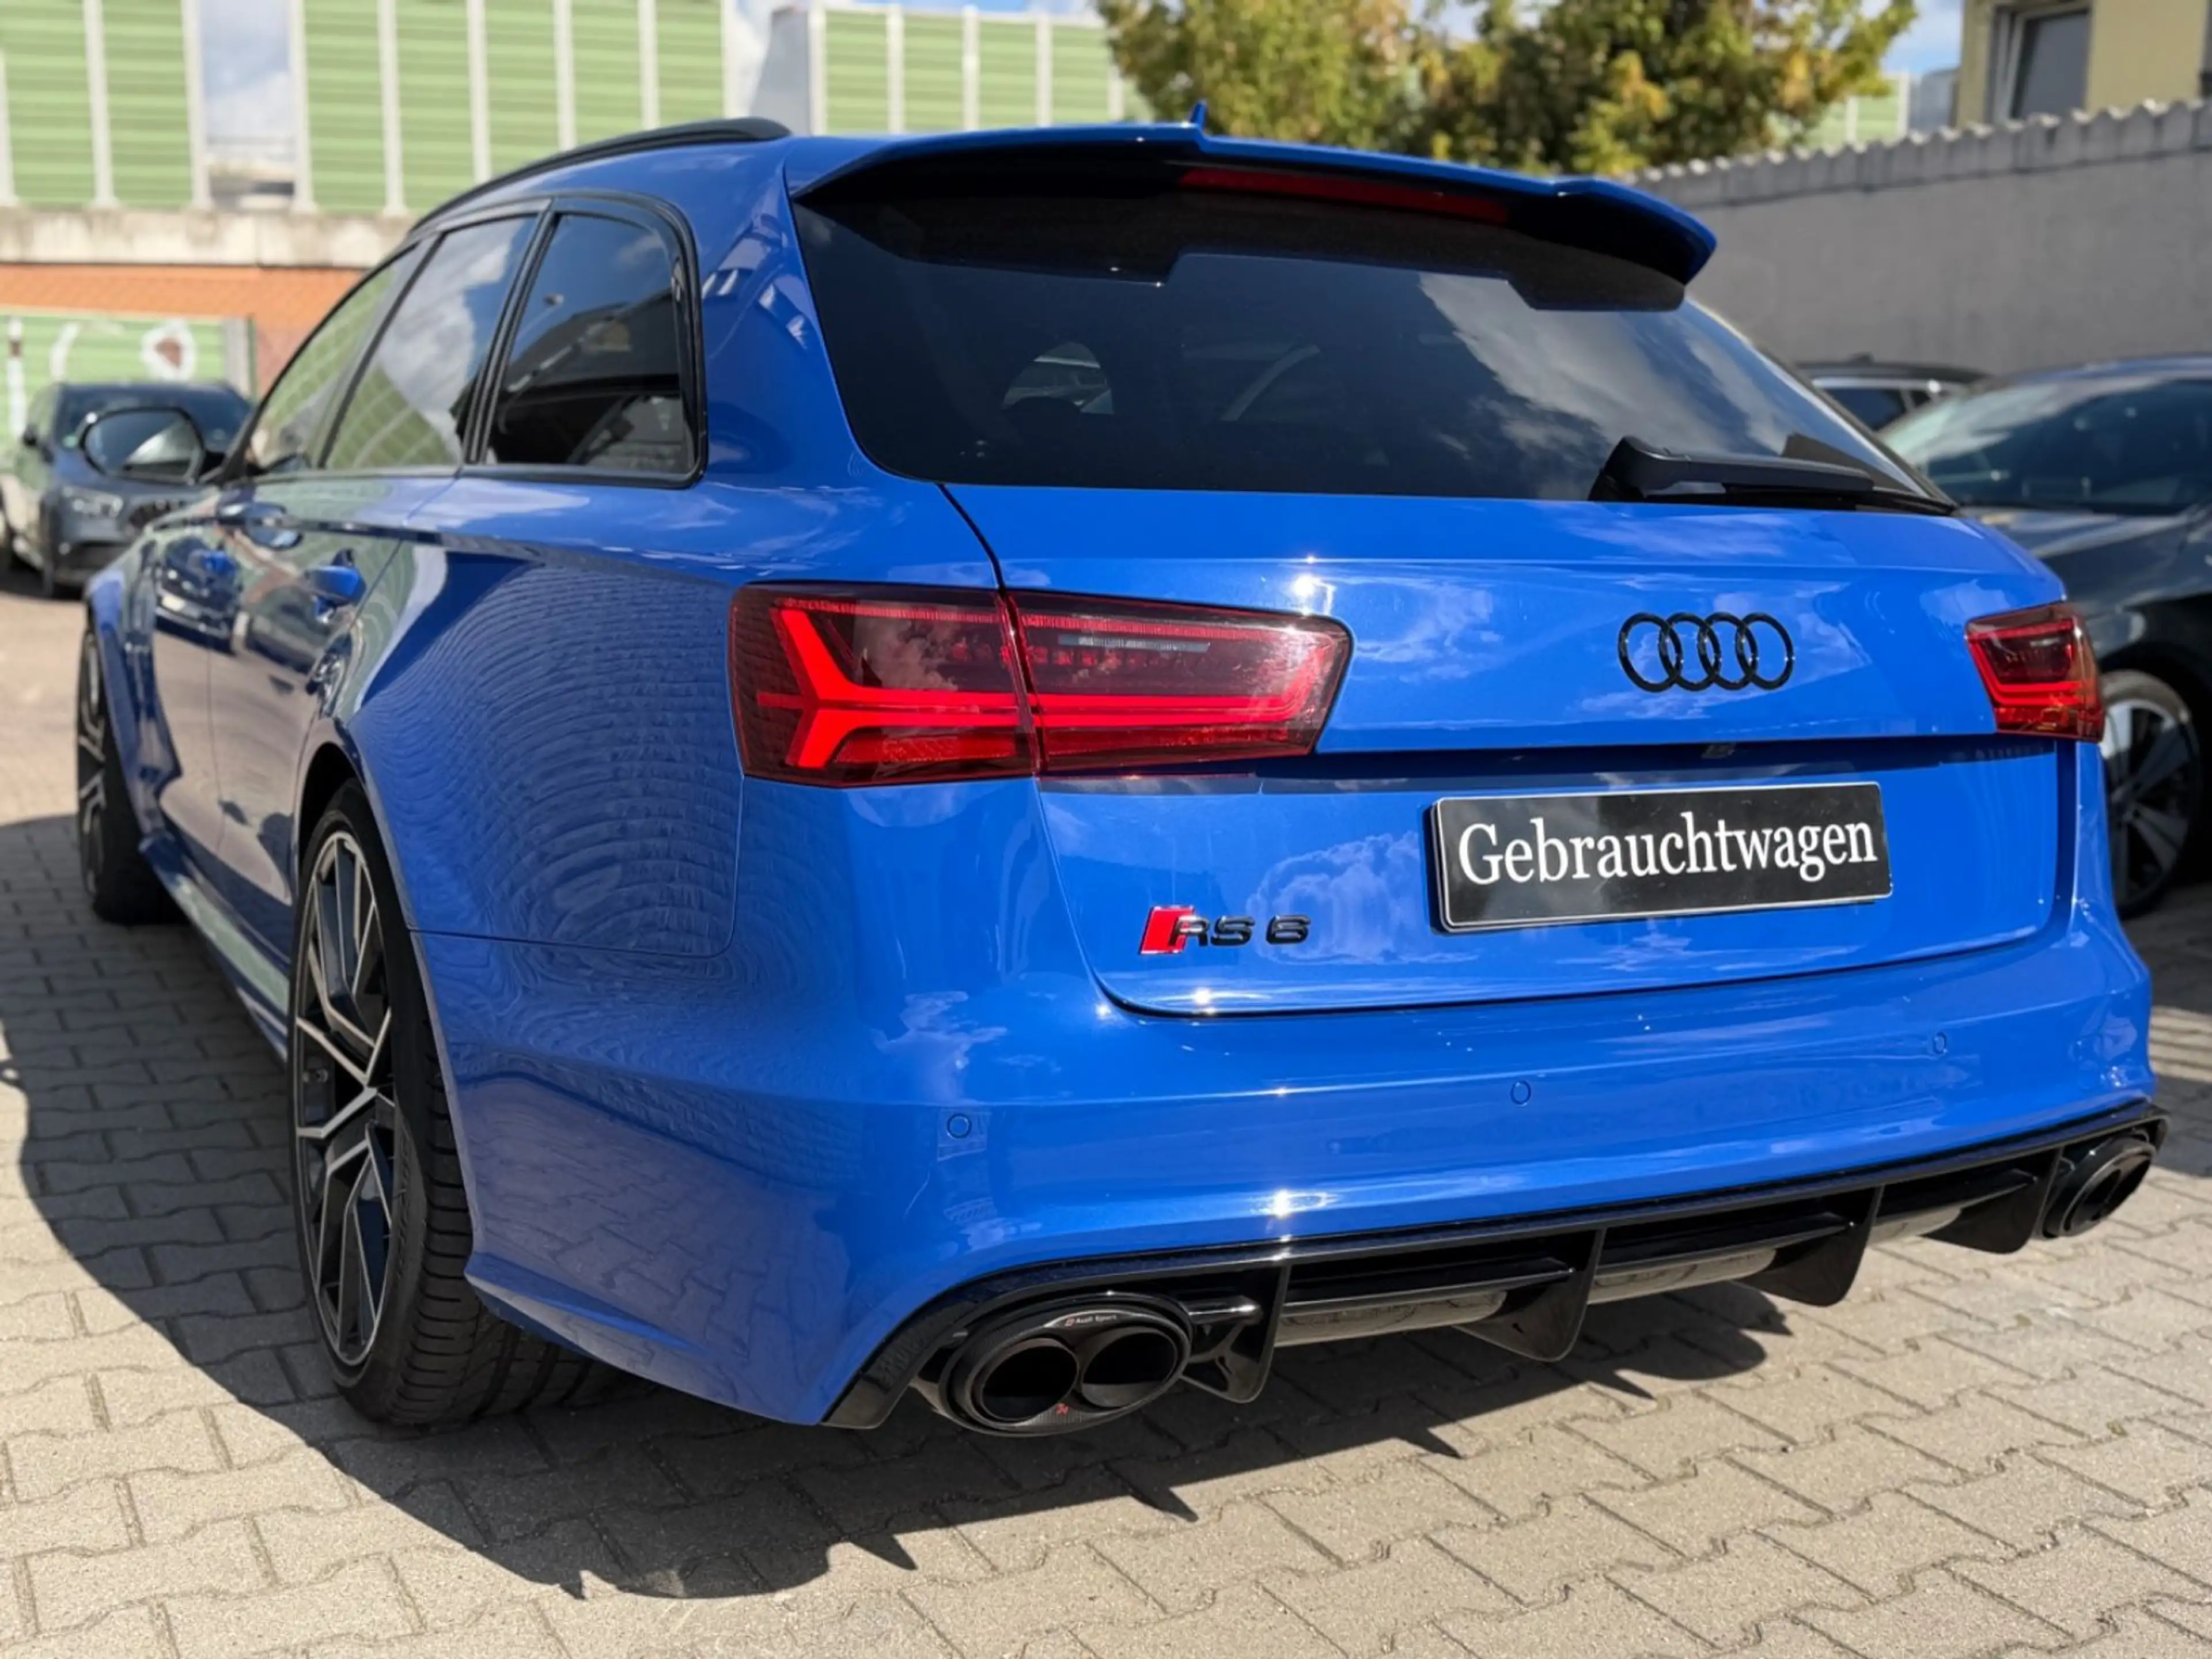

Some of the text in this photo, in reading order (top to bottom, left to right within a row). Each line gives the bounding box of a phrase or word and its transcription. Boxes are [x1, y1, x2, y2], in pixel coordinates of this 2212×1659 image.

[1458, 811, 1878, 885] Gebrauchtwagen
[1168, 915, 1311, 946] RS 6
